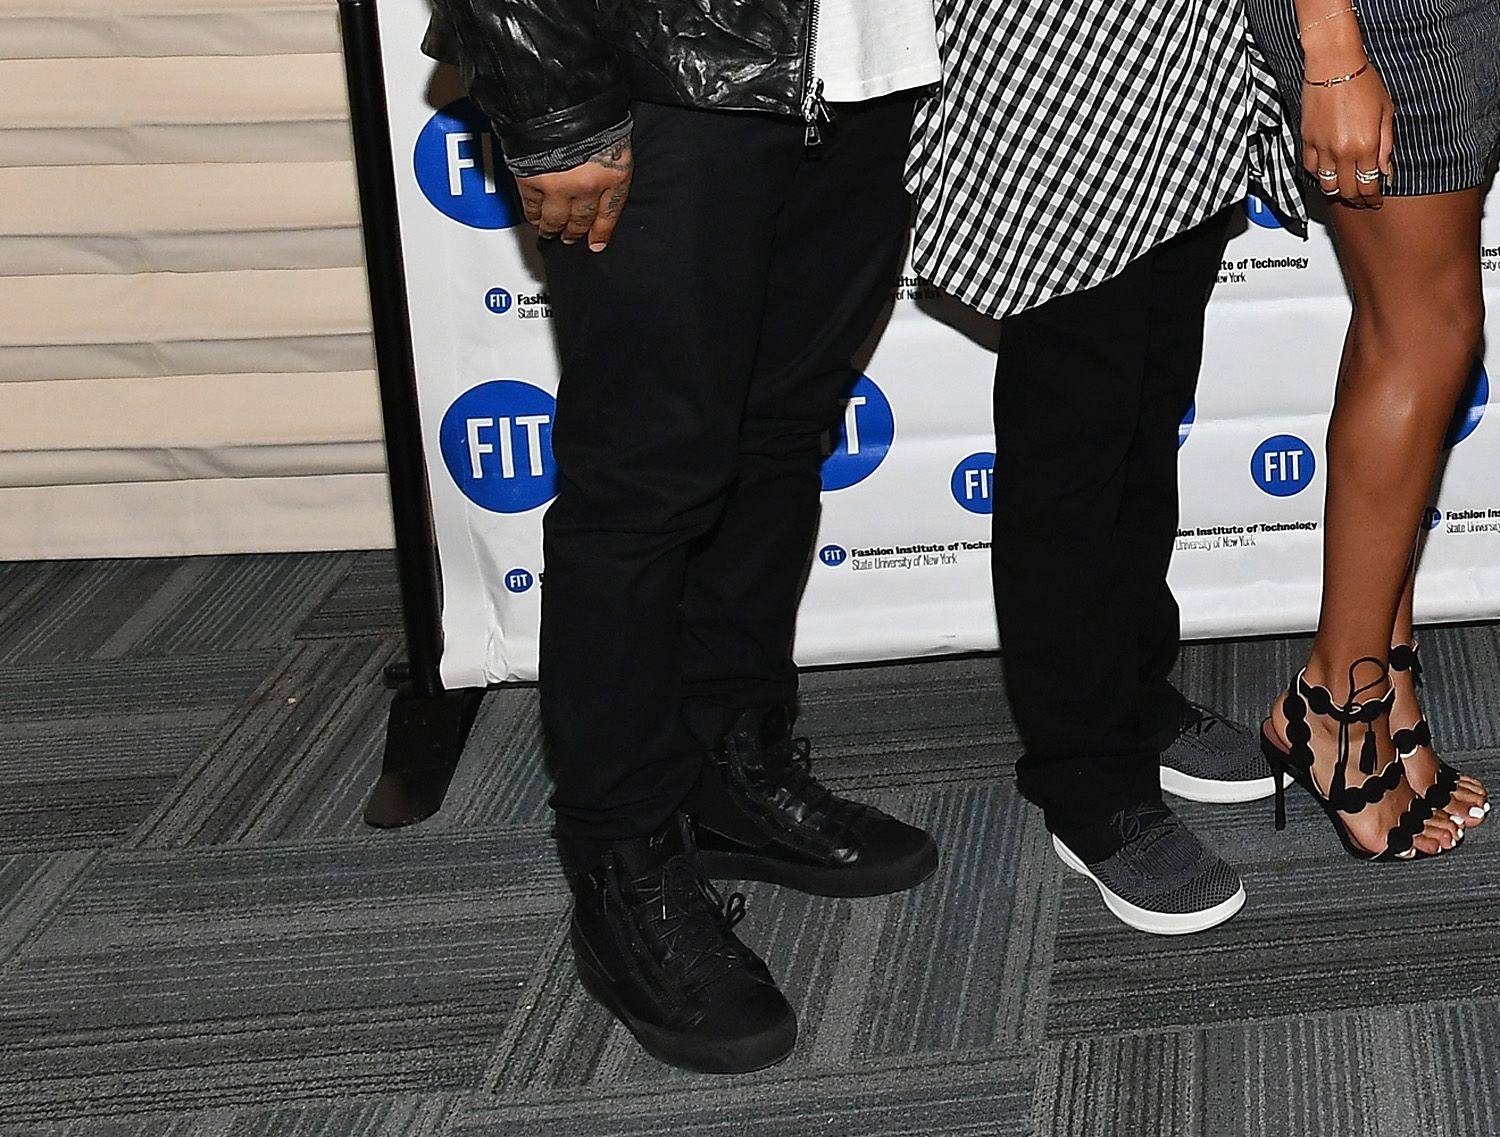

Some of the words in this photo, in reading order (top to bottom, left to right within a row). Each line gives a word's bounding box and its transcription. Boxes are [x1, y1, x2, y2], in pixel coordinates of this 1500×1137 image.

[445, 132, 497, 196] FI
[1237, 258, 1248, 269] of
[1250, 257, 1309, 269] Technology
[490, 294, 507, 308] FIT
[467, 415, 550, 480] FIT
[1264, 450, 1303, 482] FIT
[1260, 521, 1317, 533] Technology
[825, 549, 841, 561] FIT
[510, 574, 528, 588] FIT
